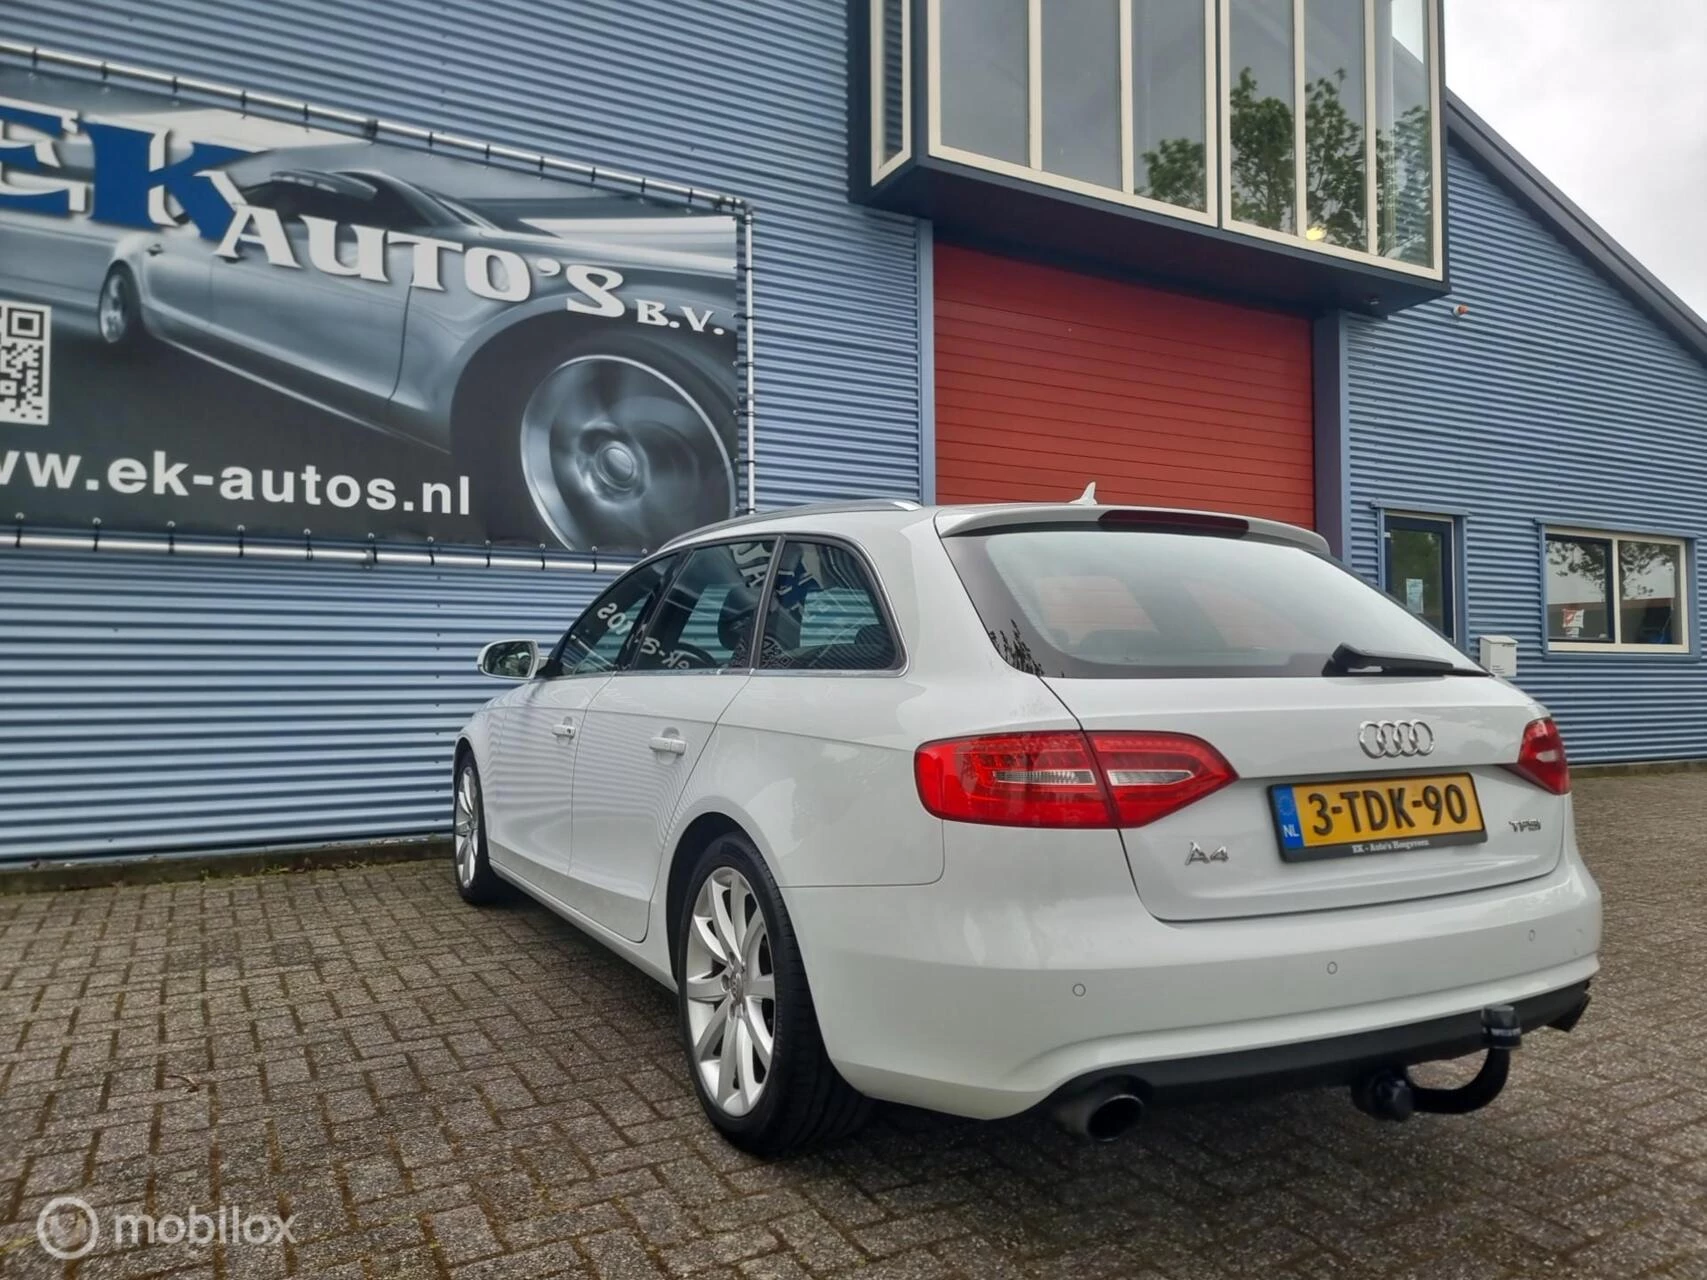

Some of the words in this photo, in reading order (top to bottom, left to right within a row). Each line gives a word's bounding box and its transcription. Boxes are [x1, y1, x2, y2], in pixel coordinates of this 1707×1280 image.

[634, 299, 725, 336] B.V.
[1308, 784, 1468, 837] 3-TDK-90
[1283, 824, 1299, 838] NL
[1184, 840, 1230, 866] A4
